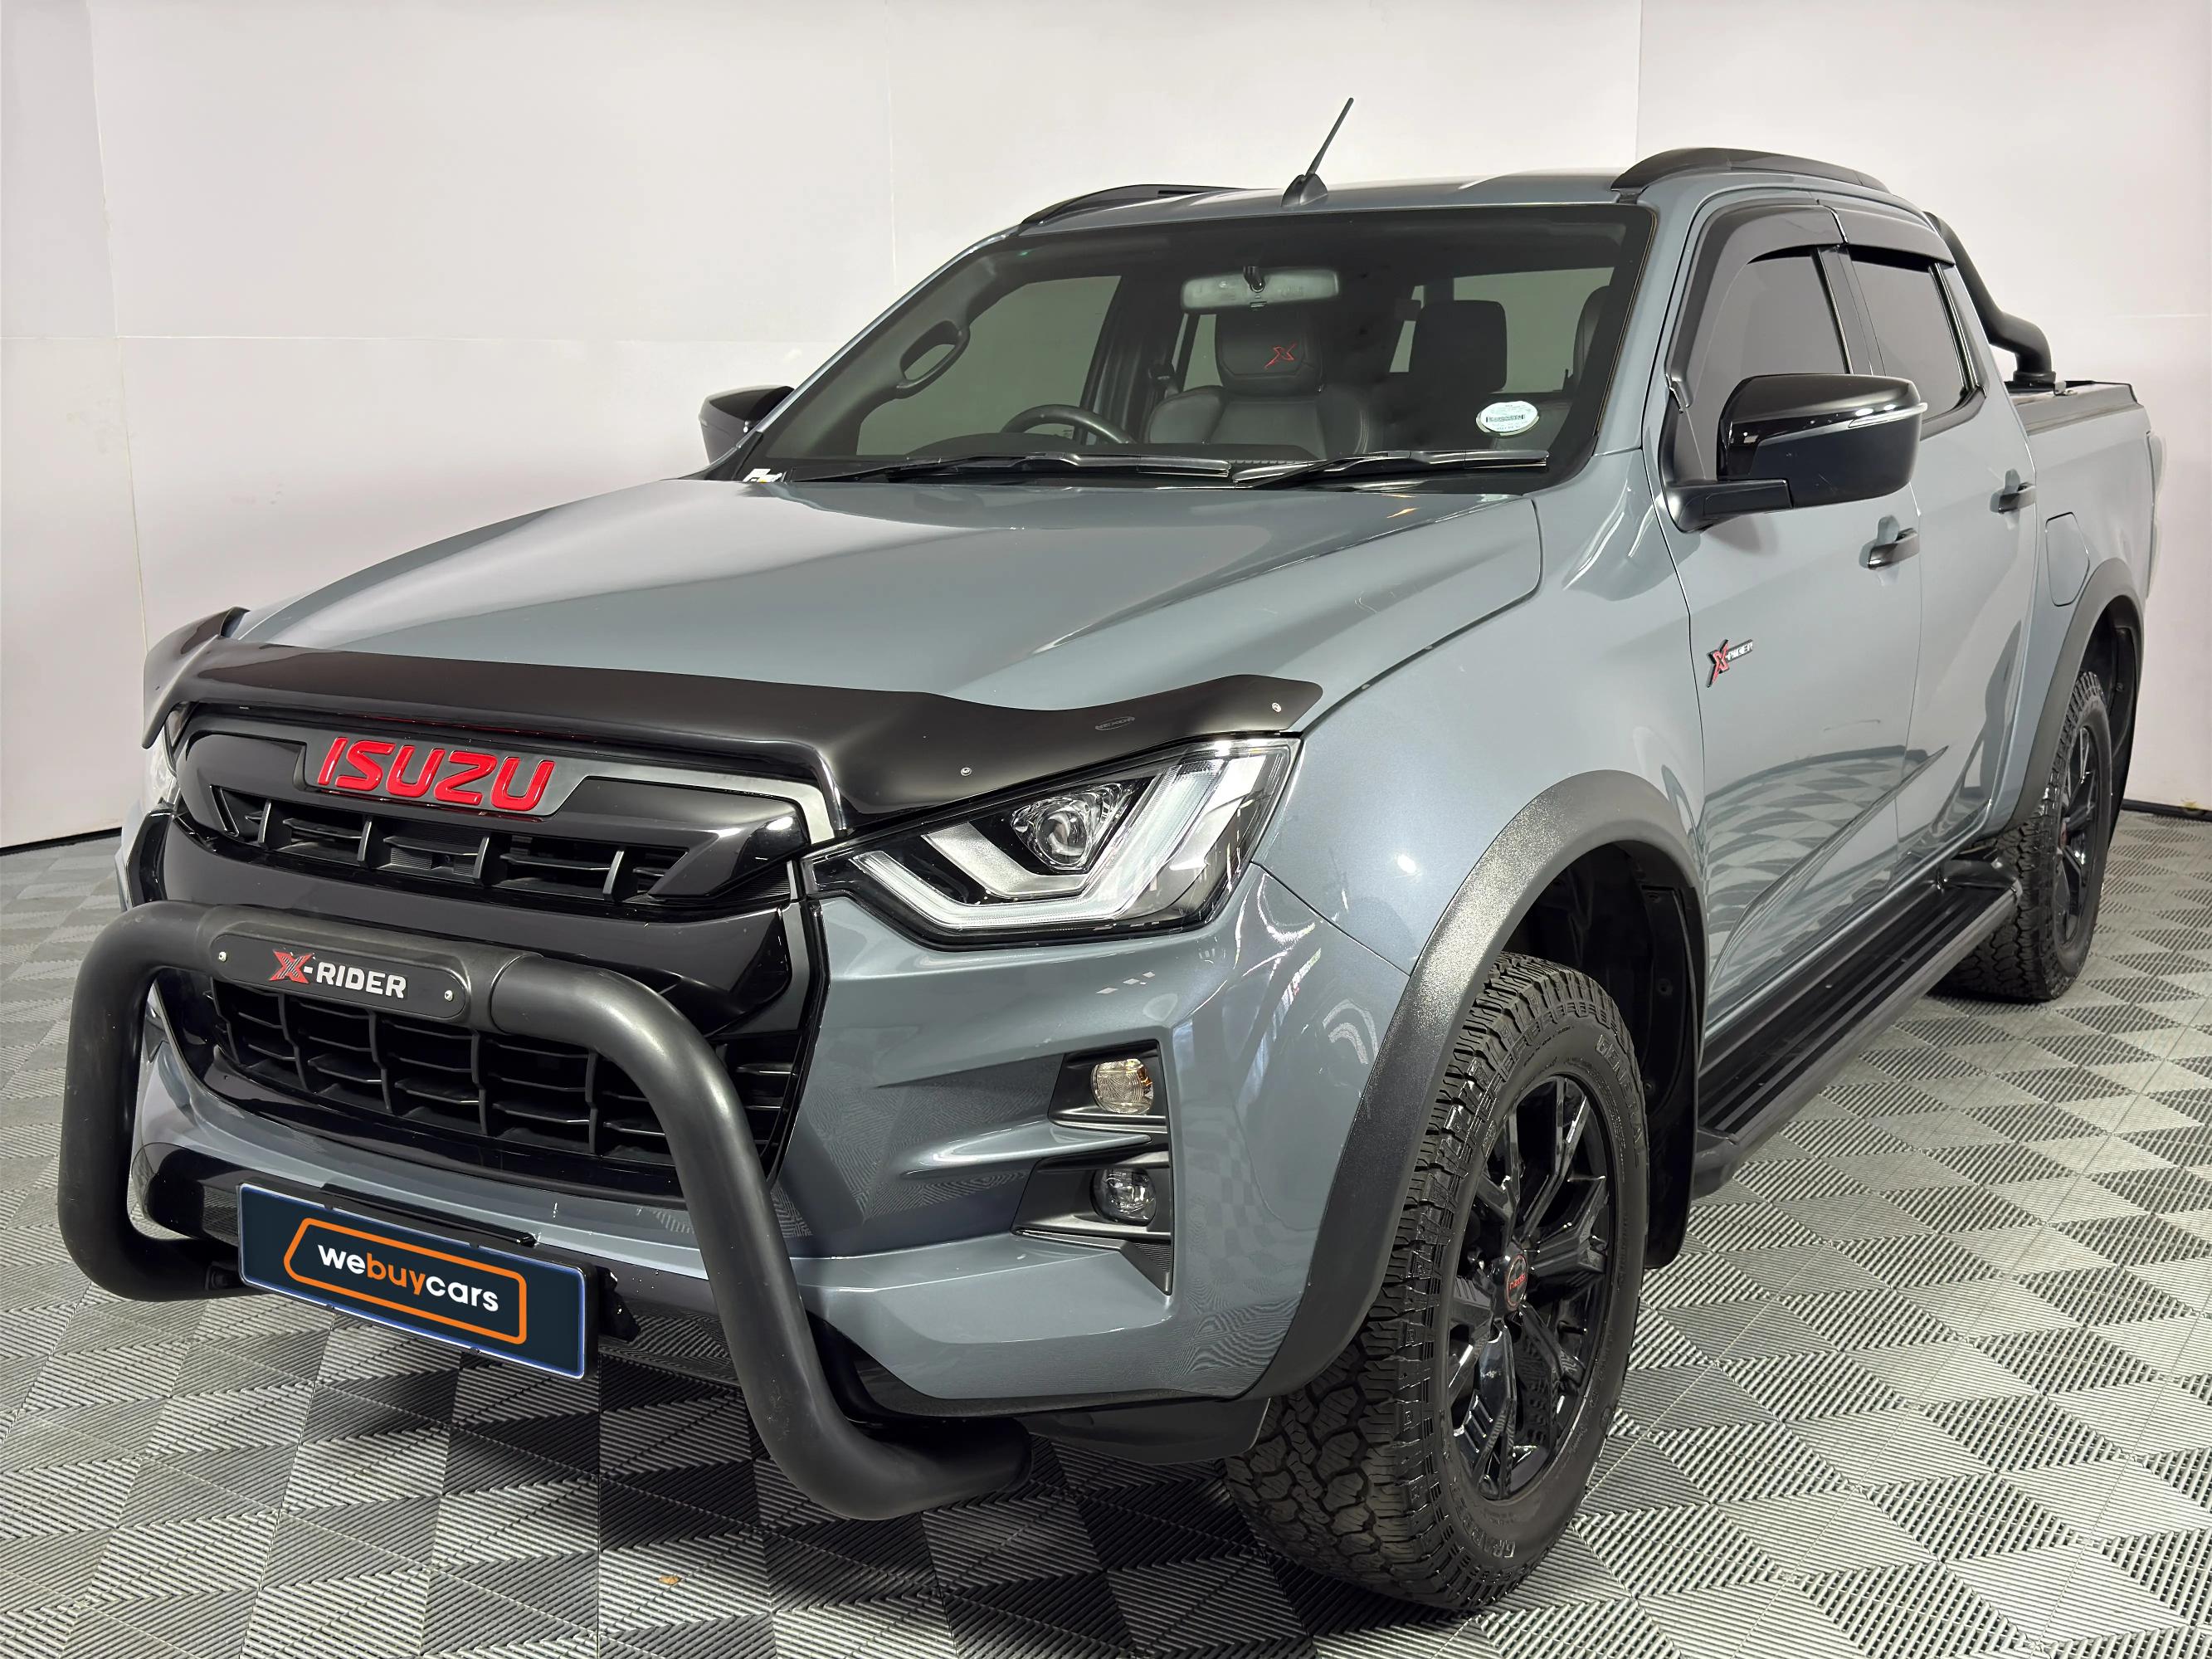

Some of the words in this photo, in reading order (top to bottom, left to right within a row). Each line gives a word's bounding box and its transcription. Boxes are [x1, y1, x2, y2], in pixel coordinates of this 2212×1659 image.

[317, 737, 555, 811] ISUZU
[269, 949, 407, 998] X-RIDER
[317, 1244, 499, 1312] webuycars
